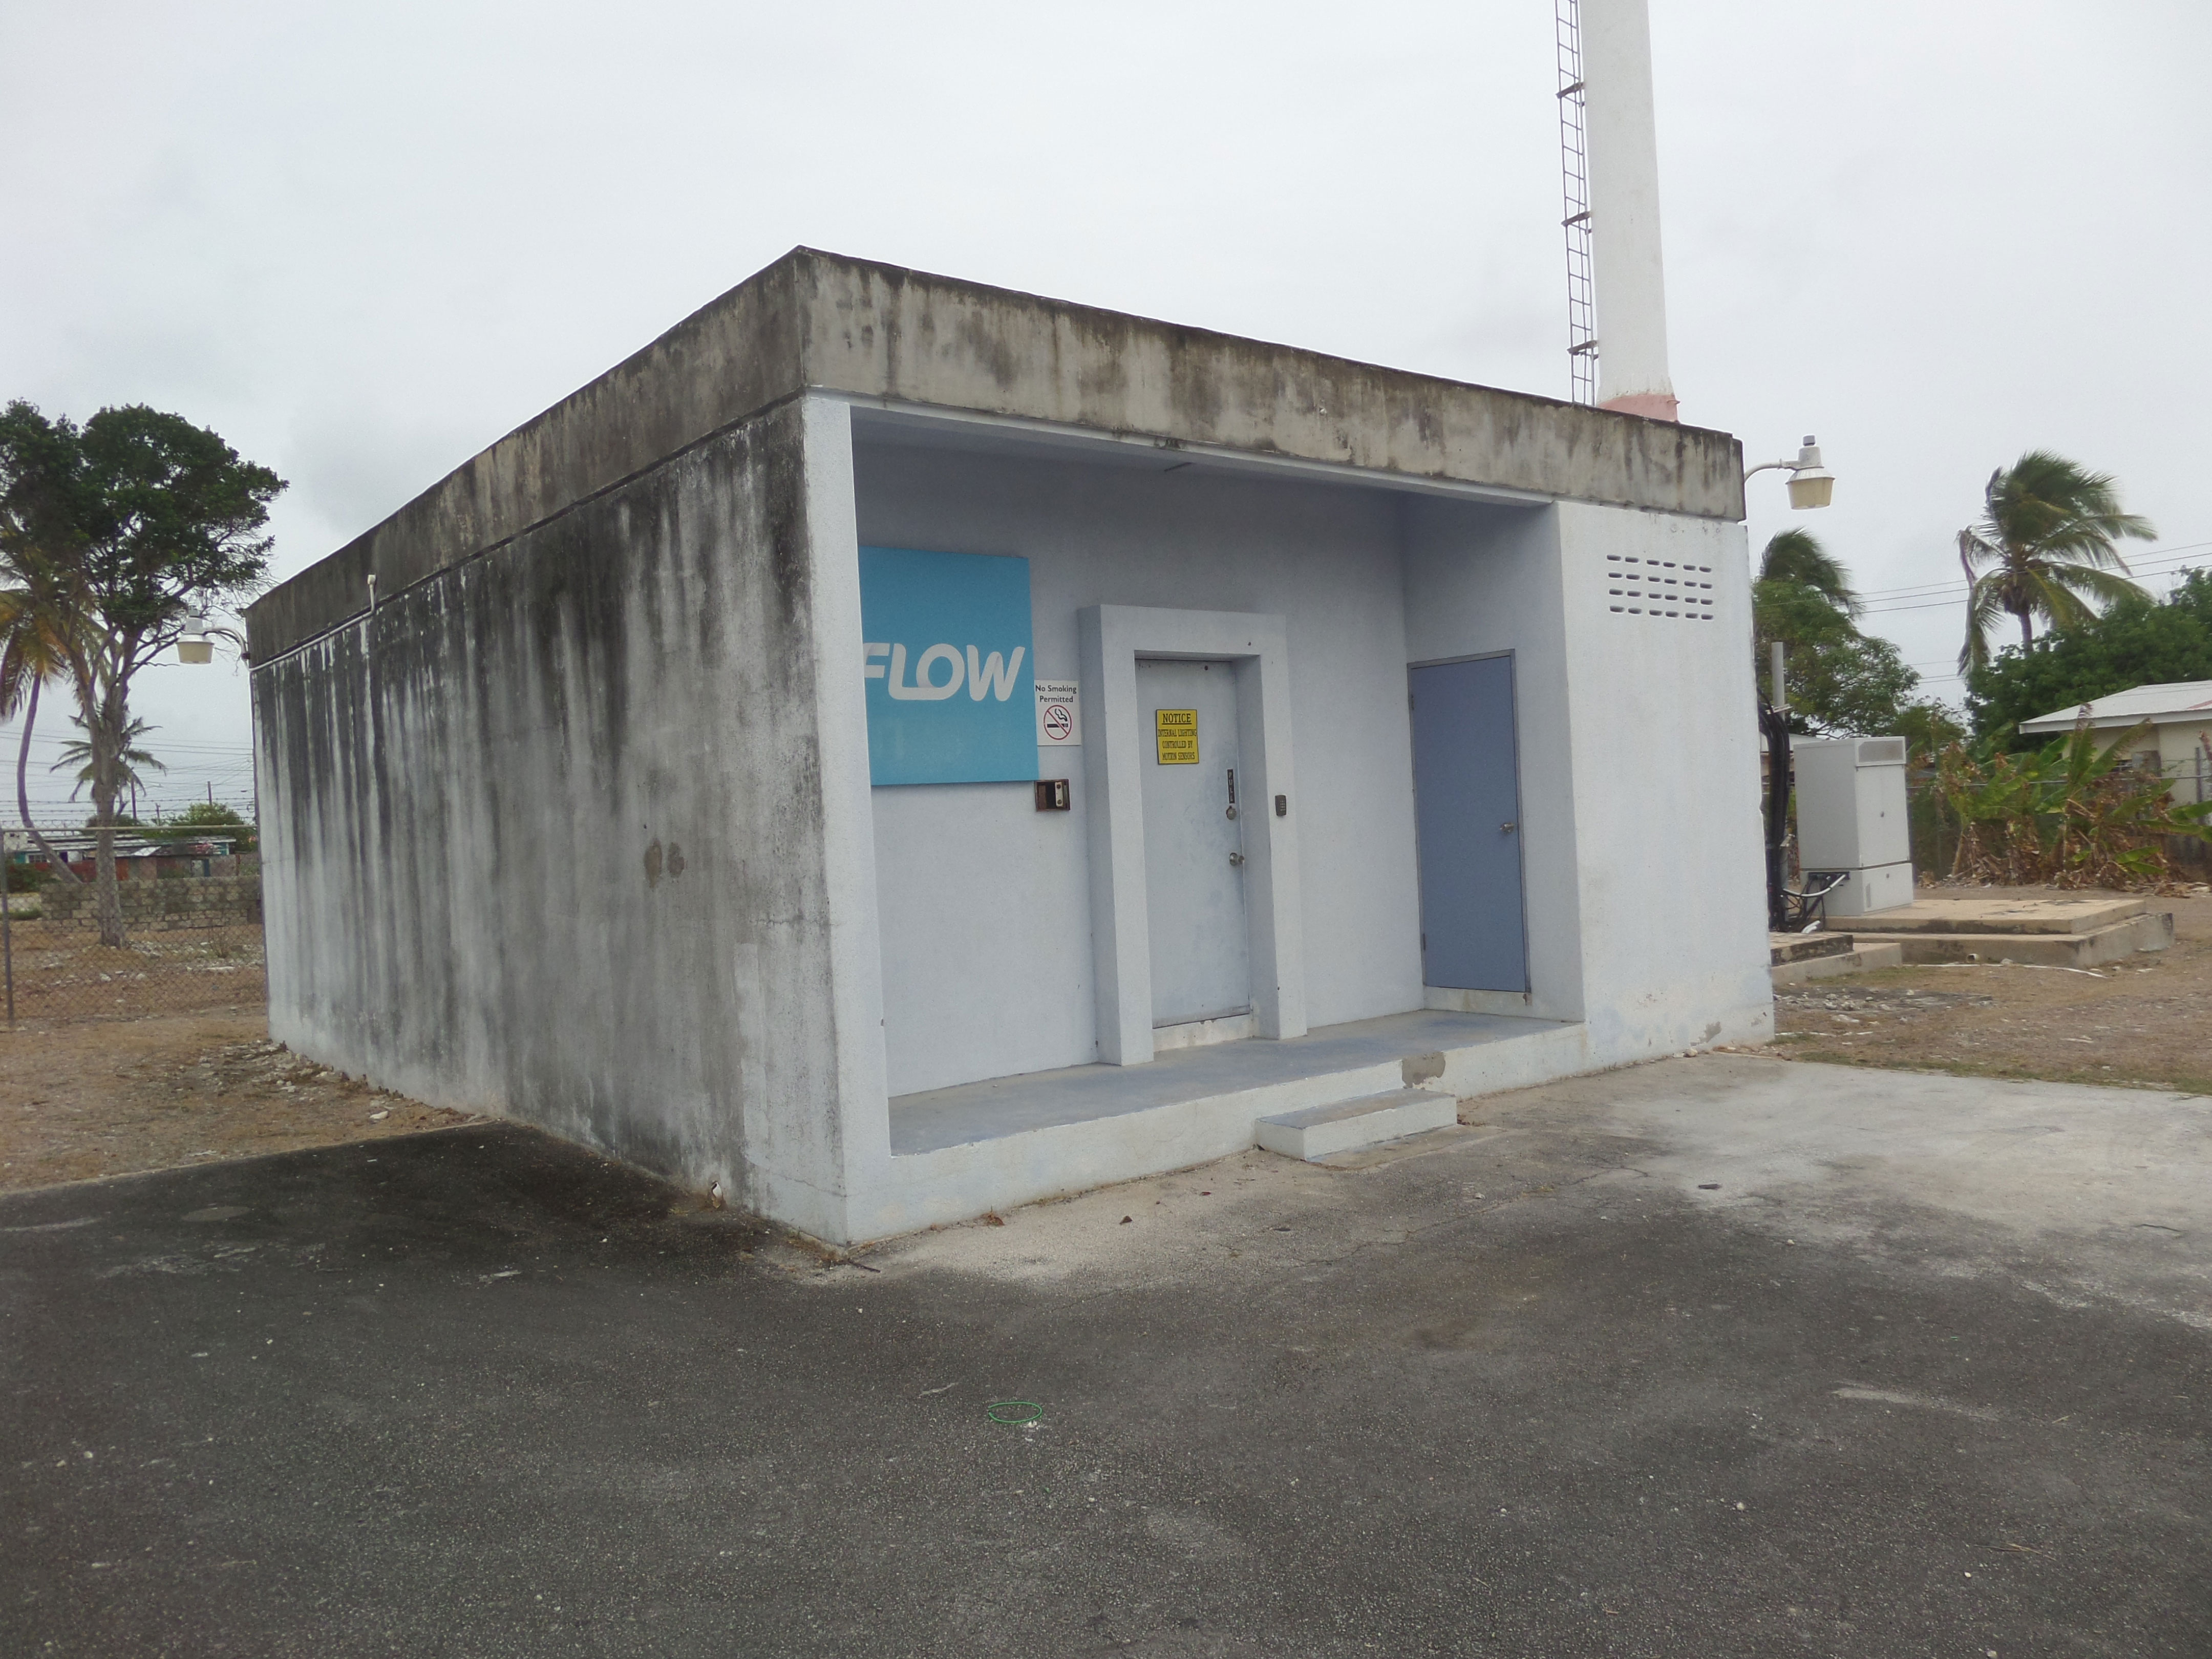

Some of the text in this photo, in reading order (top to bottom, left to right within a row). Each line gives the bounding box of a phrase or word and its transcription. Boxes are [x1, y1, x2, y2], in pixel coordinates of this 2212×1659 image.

[863, 643, 1025, 701] FLOW
[1048, 685, 1077, 694] Smoking
[1163, 713, 1191, 723] NOTICE
[1178, 729, 1197, 737] LIGHTING
[1162, 752, 1195, 760] MOTION SENSORS
